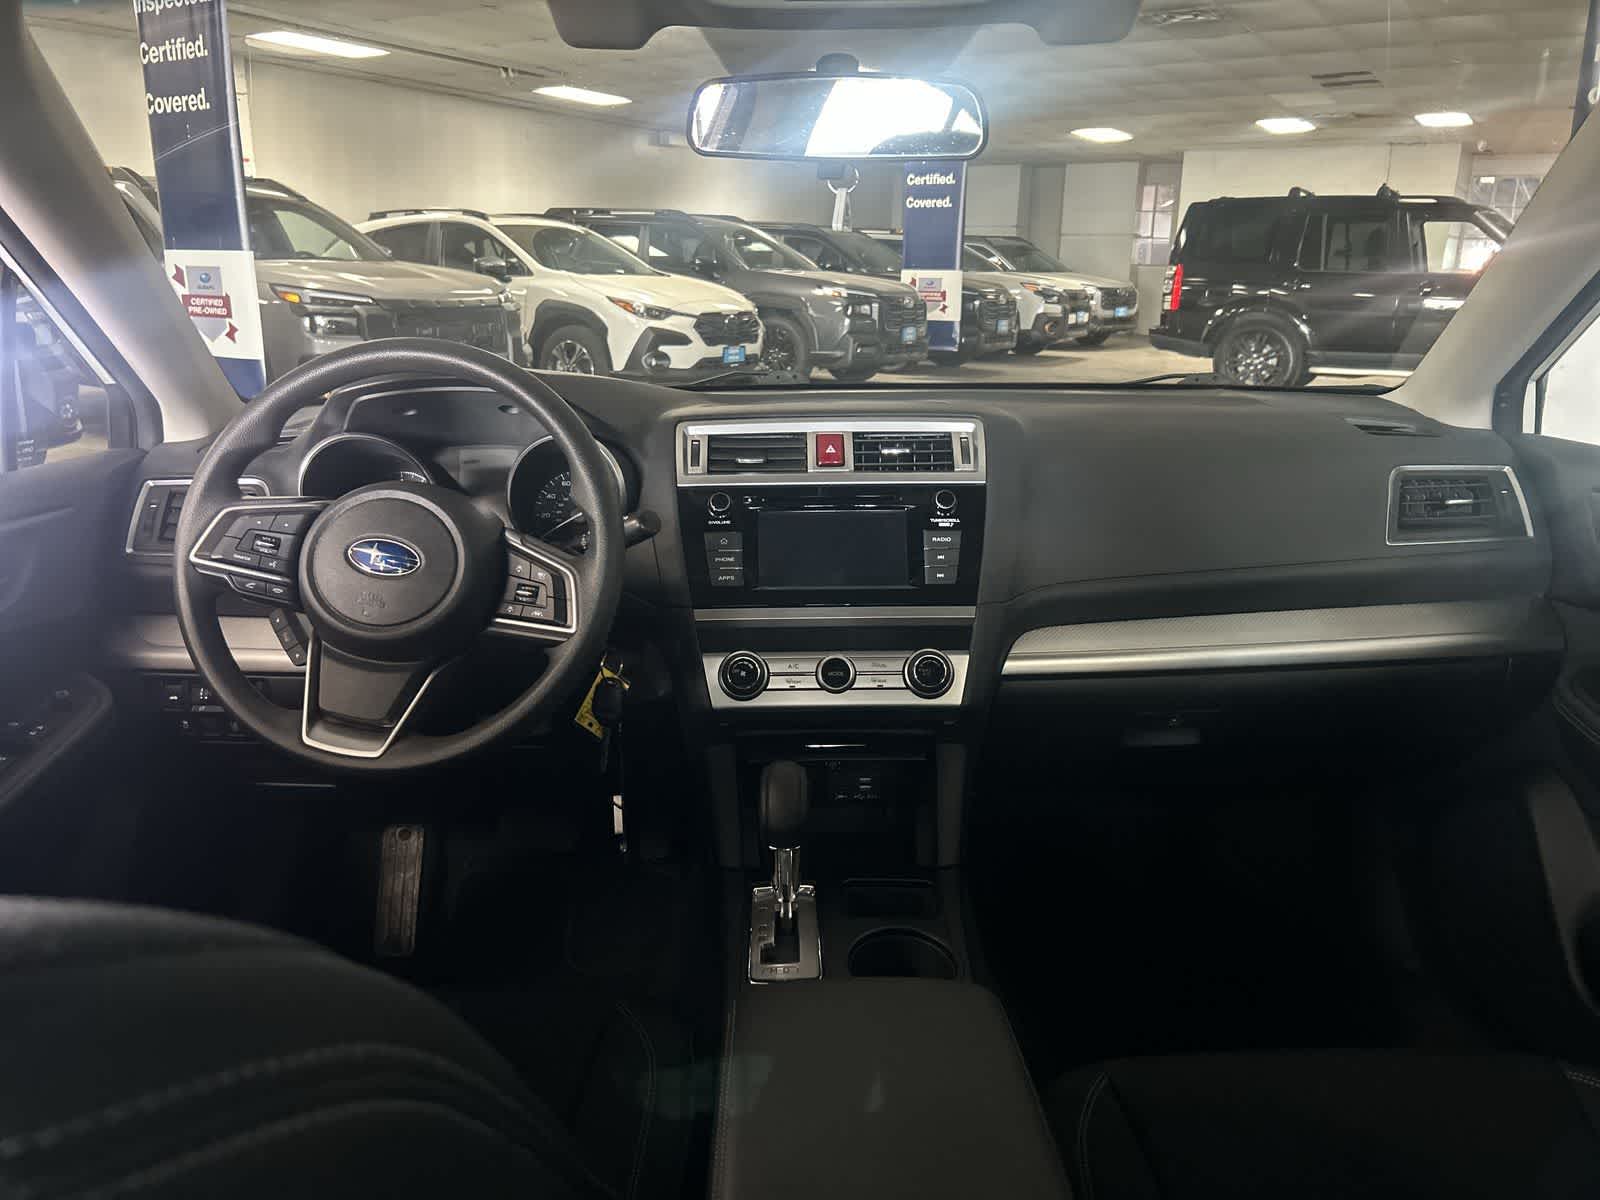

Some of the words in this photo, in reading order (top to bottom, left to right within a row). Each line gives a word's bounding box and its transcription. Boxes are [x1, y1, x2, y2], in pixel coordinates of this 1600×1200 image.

[140, 34, 208, 64] Certified.
[146, 87, 210, 115] Covered.
[907, 172, 955, 185] Certified.
[906, 196, 952, 209] Covered.
[190, 297, 224, 307] CERTIFIED
[188, 306, 228, 315] PRE-OWNED
